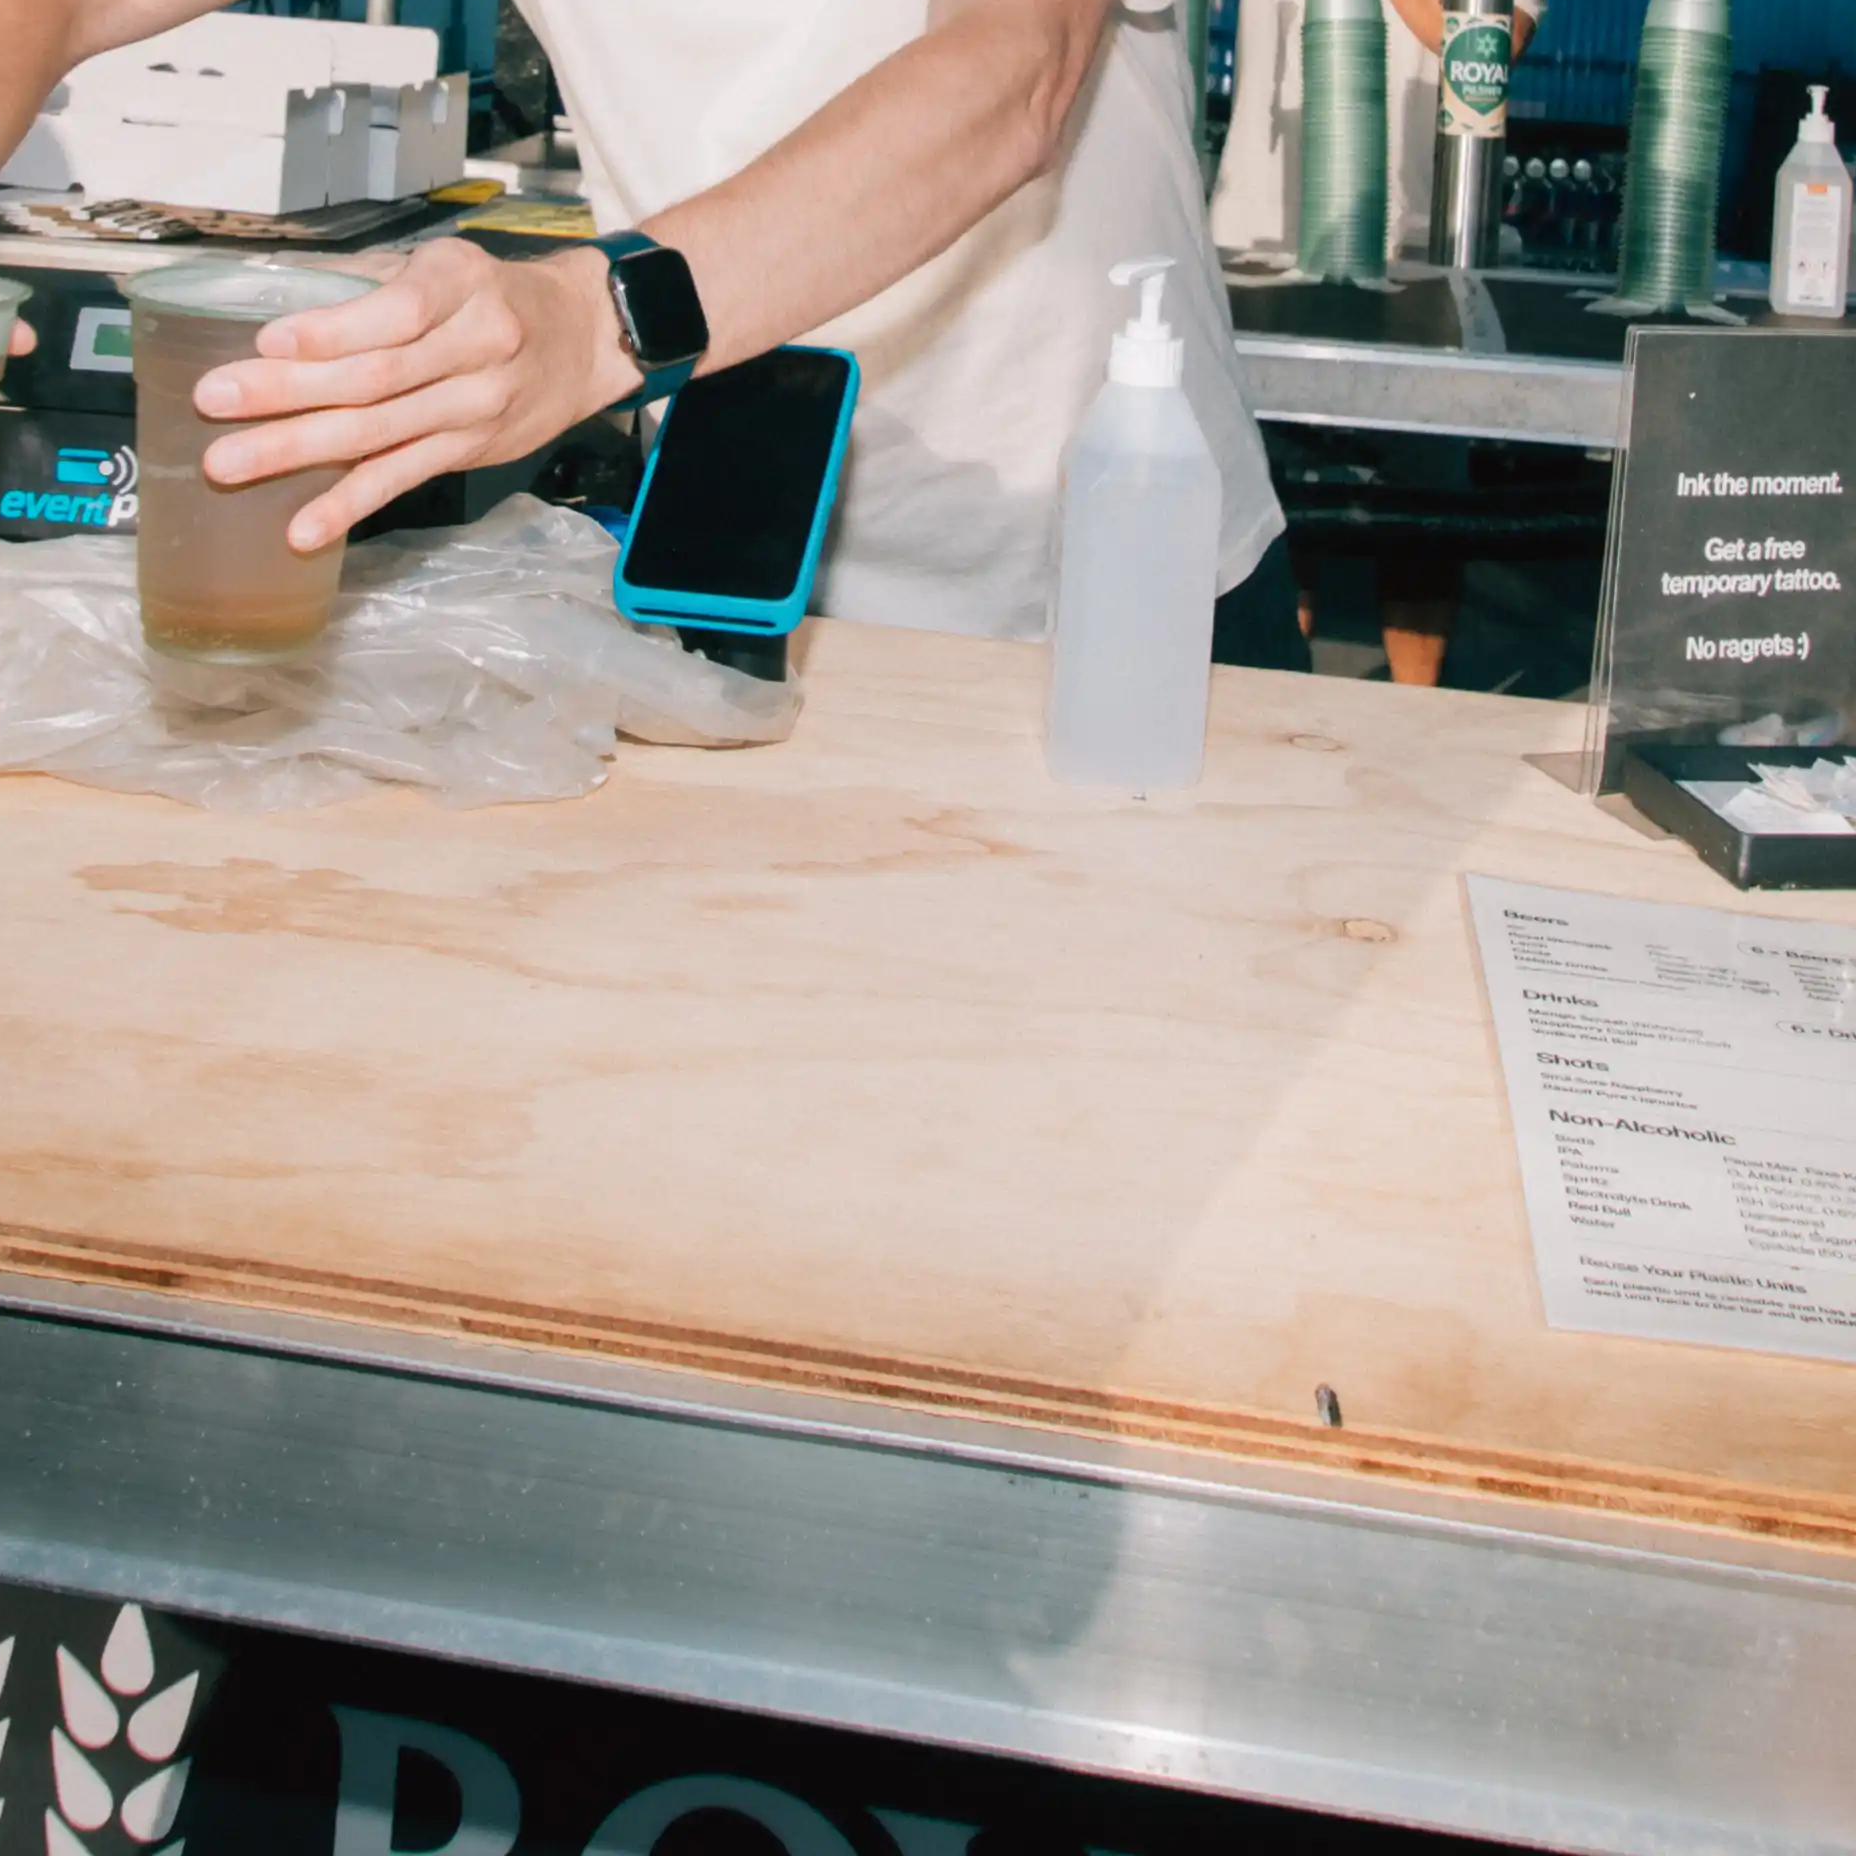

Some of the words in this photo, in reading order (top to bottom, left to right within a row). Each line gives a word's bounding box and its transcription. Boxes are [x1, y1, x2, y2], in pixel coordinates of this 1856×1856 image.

[1677, 472, 1710, 496] Ink
[1714, 472, 1748, 496] the
[1751, 471, 1843, 495] moment.
[1704, 537, 1744, 561] Get
[1747, 542, 1762, 560] a
[1764, 537, 1806, 560] free
[1662, 572, 1772, 598] temporary
[1775, 568, 1840, 591] tattoo.
[1686, 636, 1716, 661] No
[1719, 633, 1794, 663] ragrets
[1504, 909, 1569, 926] Beers
[1523, 989, 1599, 1008] Drinks
[1536, 1052, 1609, 1072] Shots
[1549, 1109, 1737, 1145] Non-Alcoholic
[1568, 1201, 1599, 1213] Red
[1651, 1198, 1691, 1210] Drink
[1579, 1255, 1639, 1273] Reuse
[1643, 1264, 1684, 1279] Your
[1690, 1269, 1753, 1286] Plastic
[1757, 1278, 1807, 1294] Units
